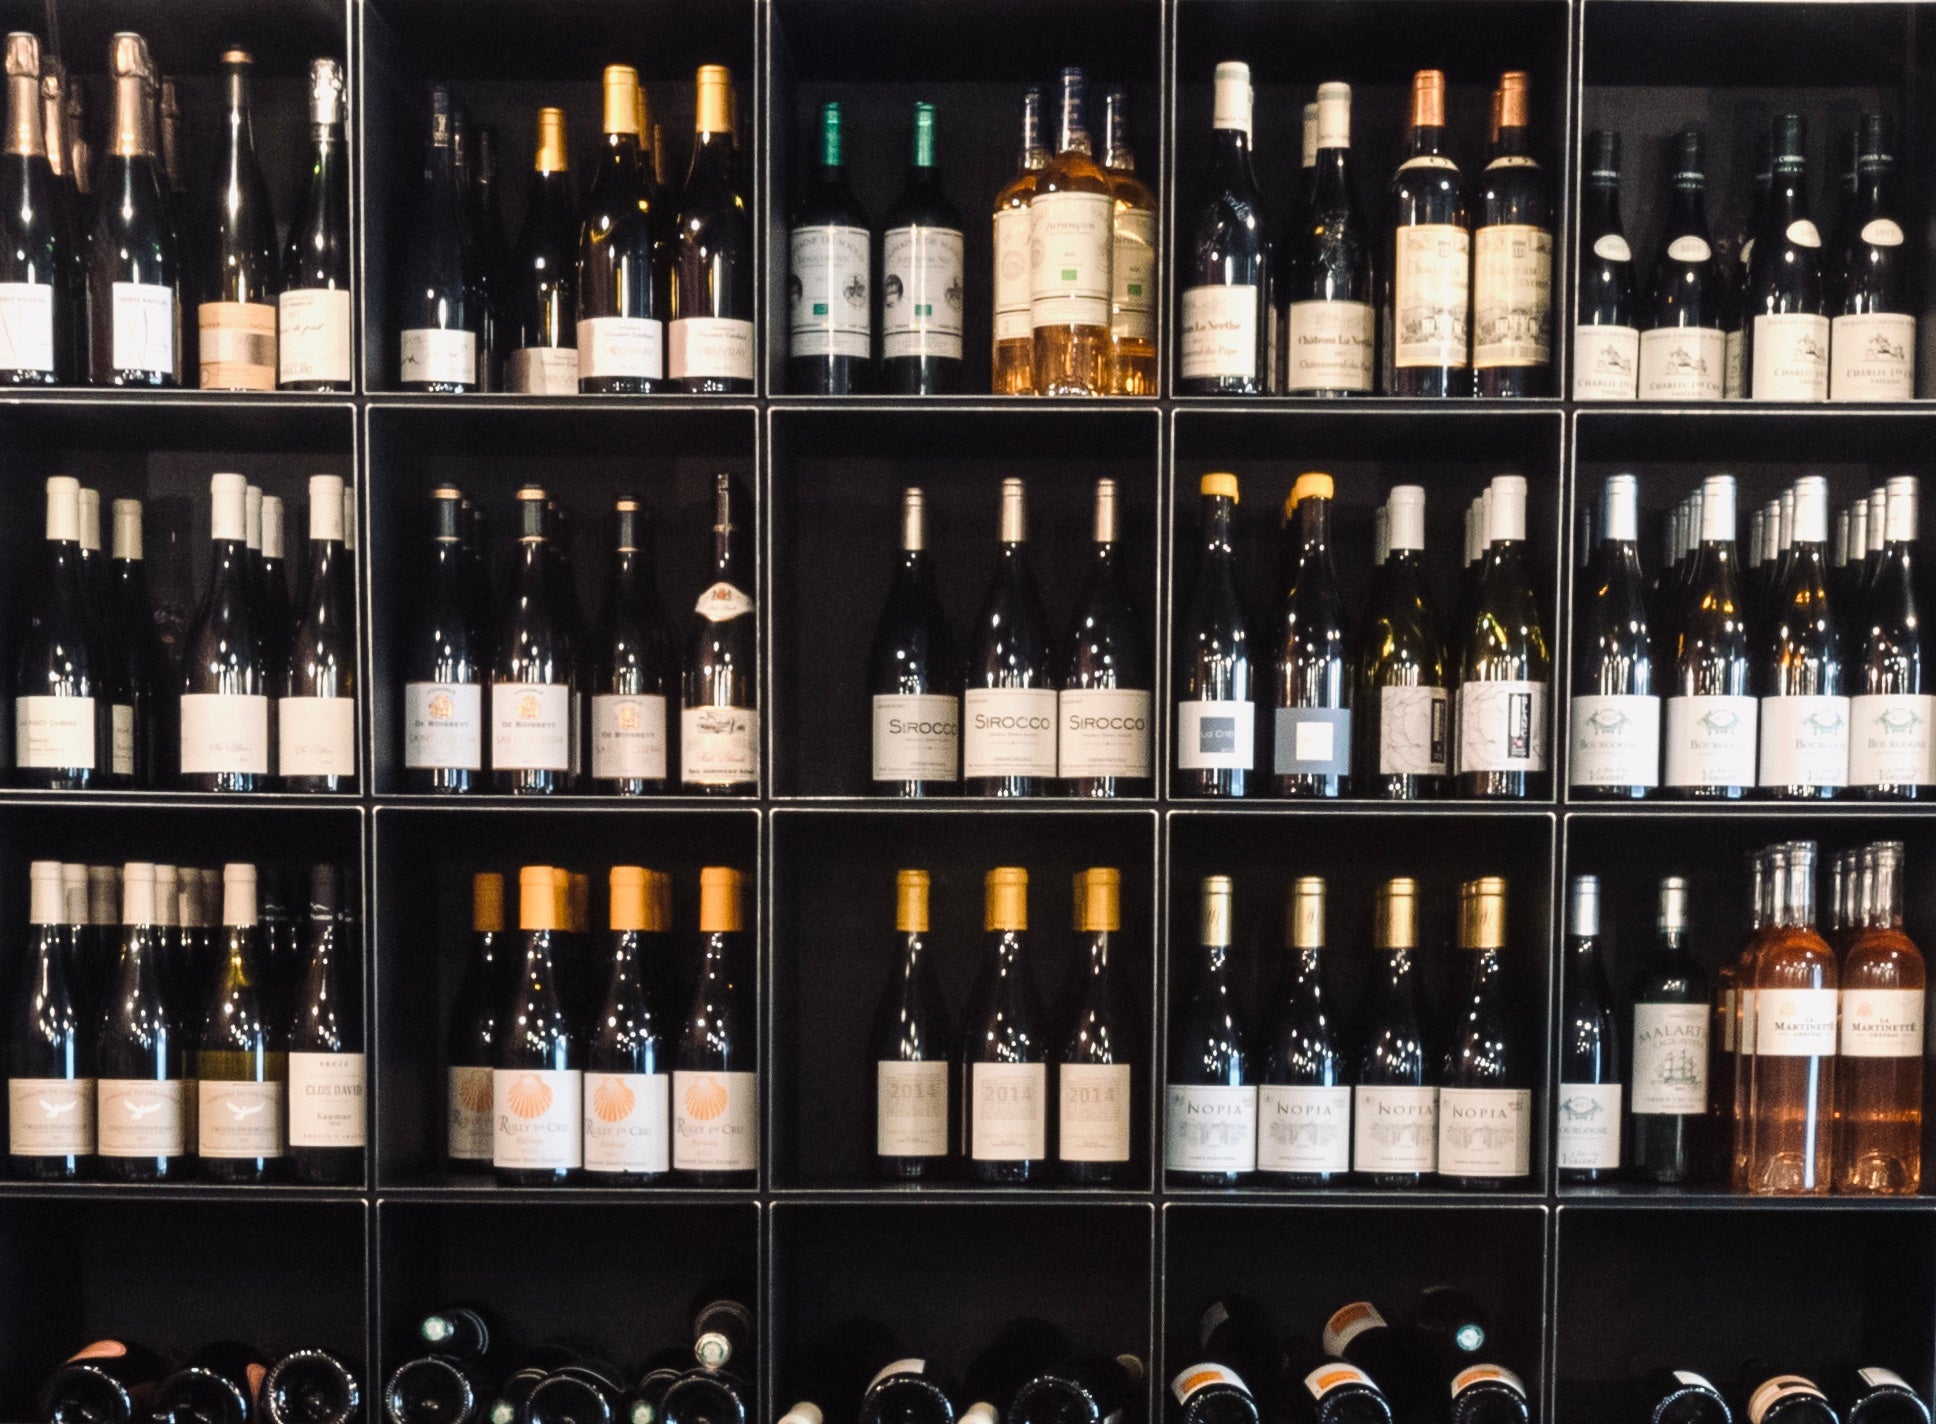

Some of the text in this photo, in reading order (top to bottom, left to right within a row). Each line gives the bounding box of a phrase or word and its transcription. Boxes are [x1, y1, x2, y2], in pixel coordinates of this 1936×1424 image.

[975, 714, 1050, 730] SIROCCO
[1069, 715, 1146, 731] SIROCCO
[306, 1085, 331, 1096] CLOS
[984, 1085, 1034, 1102] 2014
[1069, 1086, 1116, 1103] 2014
[1558, 1126, 1608, 1135] OURGOGNE
